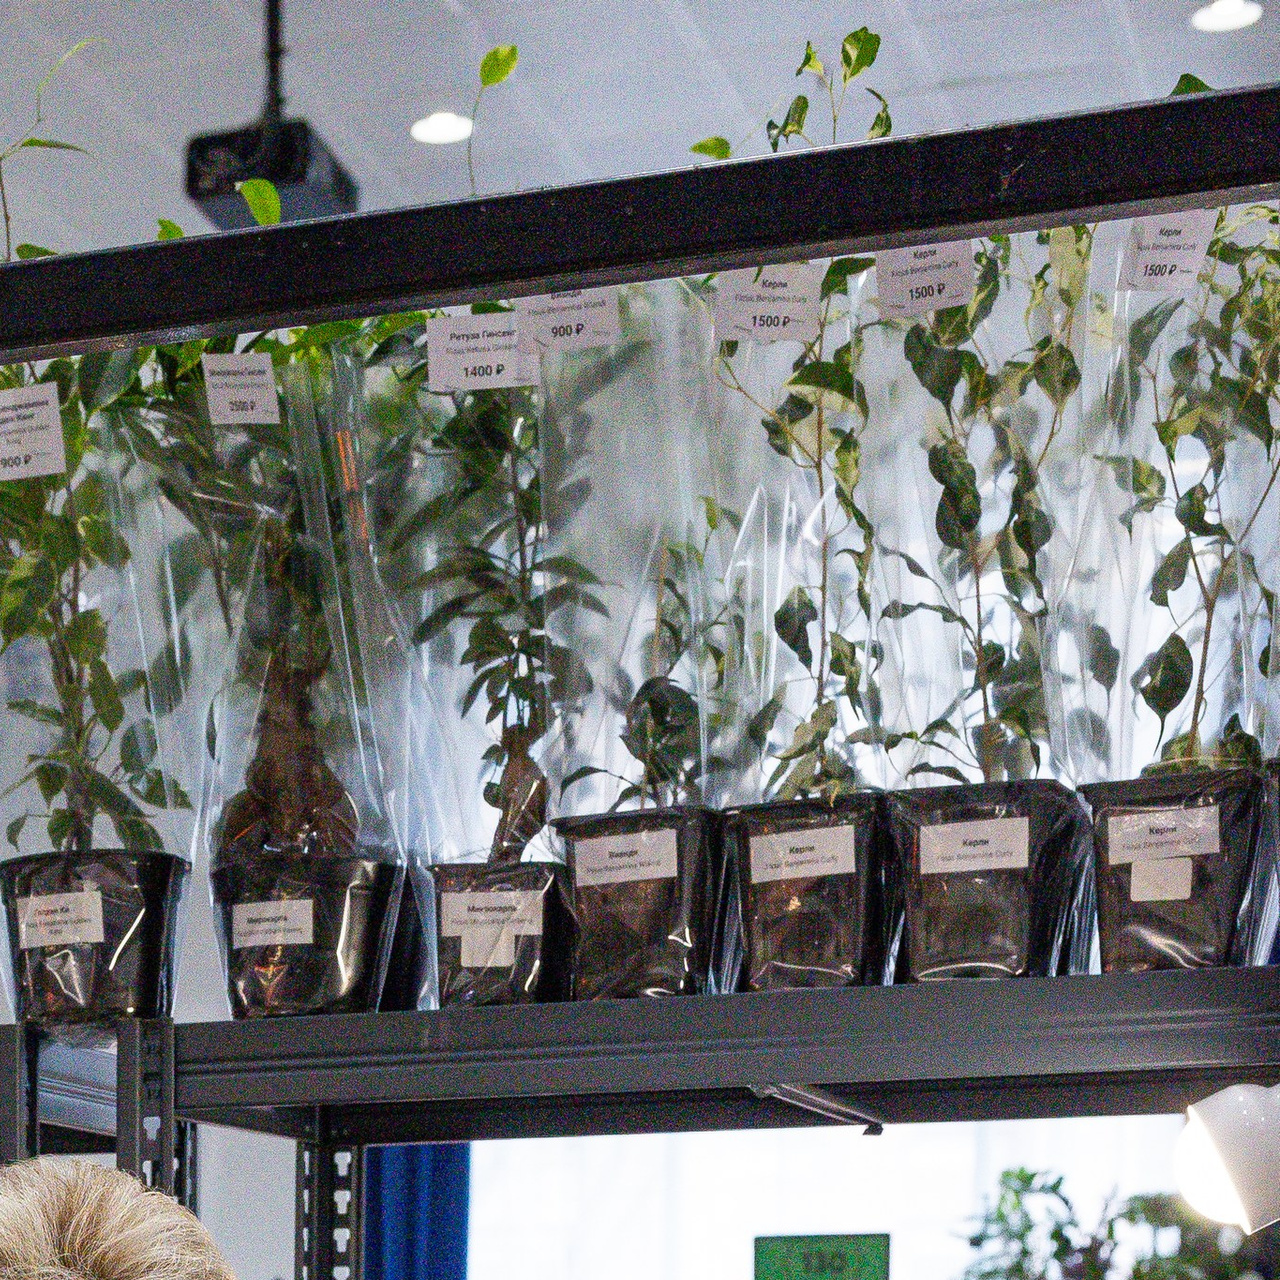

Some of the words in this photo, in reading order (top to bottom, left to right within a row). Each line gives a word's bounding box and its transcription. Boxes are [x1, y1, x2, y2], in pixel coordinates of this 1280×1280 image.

[913, 248, 937, 259] Керли
[1143, 263, 1167, 277] 1500
[761, 279, 788, 290] Керли
[909, 285, 935, 300] 1500
[751, 315, 780, 328] 1500
[552, 324, 573, 337] 900
[463, 365, 493, 378] 1400
[0, 457, 21, 468] 900
